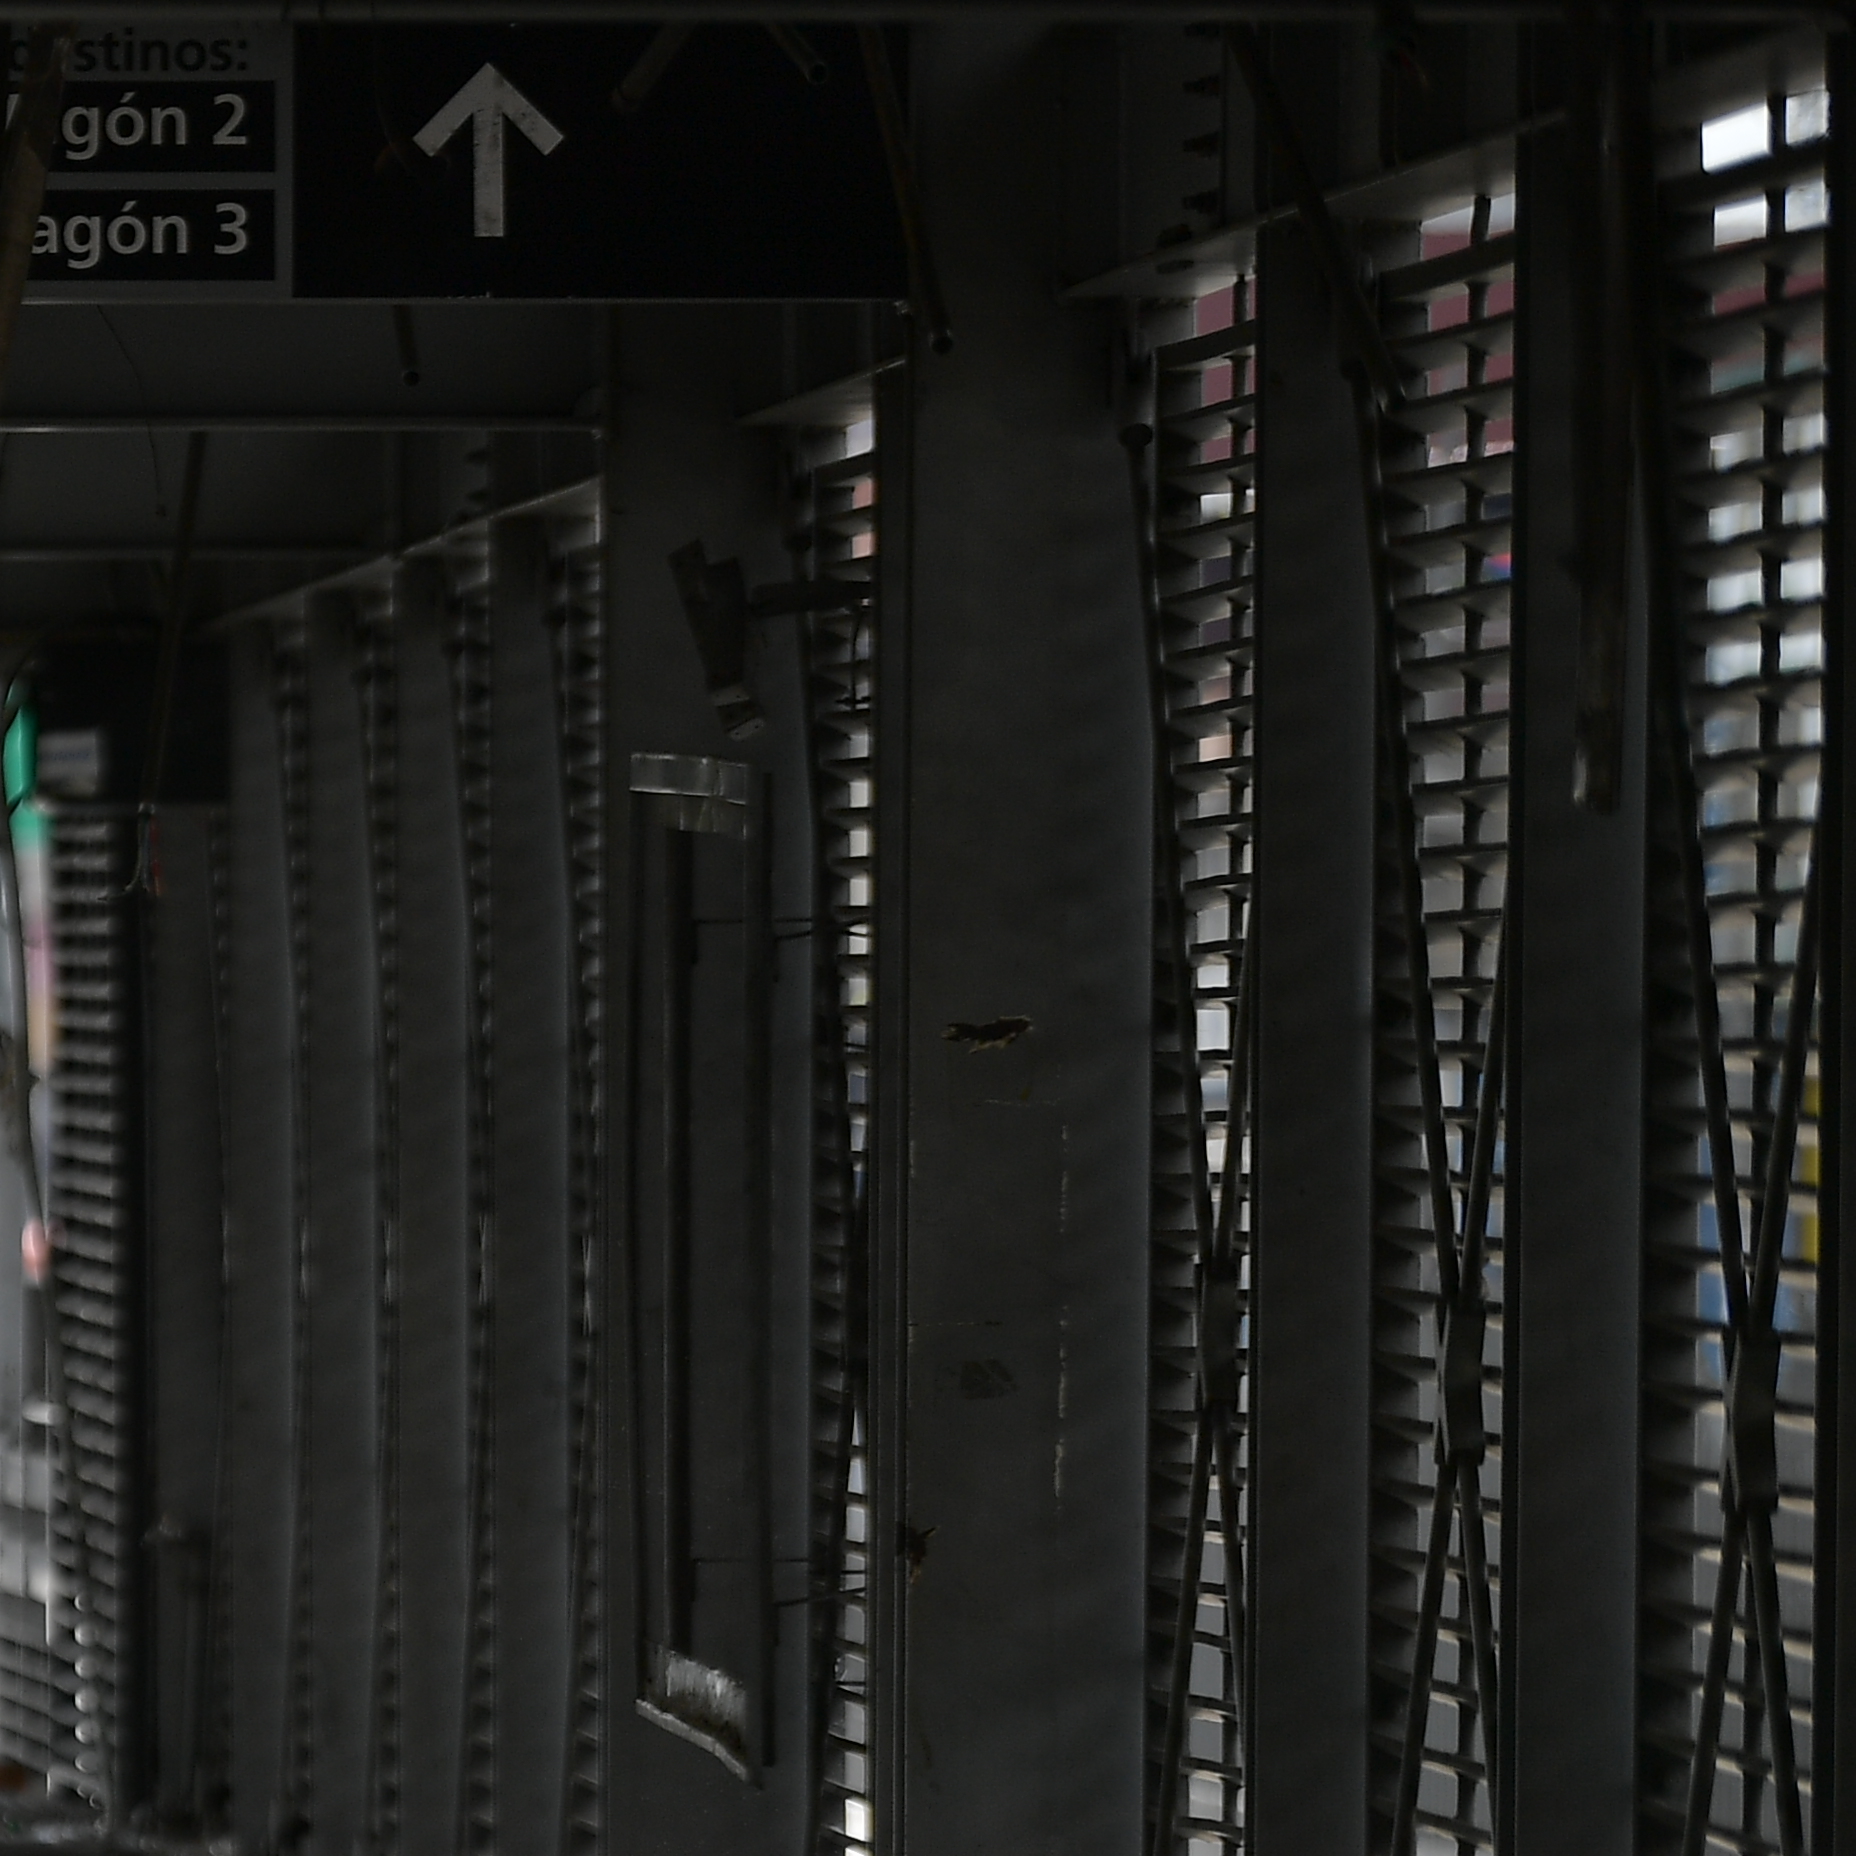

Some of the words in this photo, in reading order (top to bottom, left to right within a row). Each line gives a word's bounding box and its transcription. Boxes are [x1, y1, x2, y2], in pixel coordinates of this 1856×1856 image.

[4, 90, 188, 161] gón
[212, 92, 248, 146] 2
[30, 200, 188, 271] agón
[213, 202, 249, 256] 3
